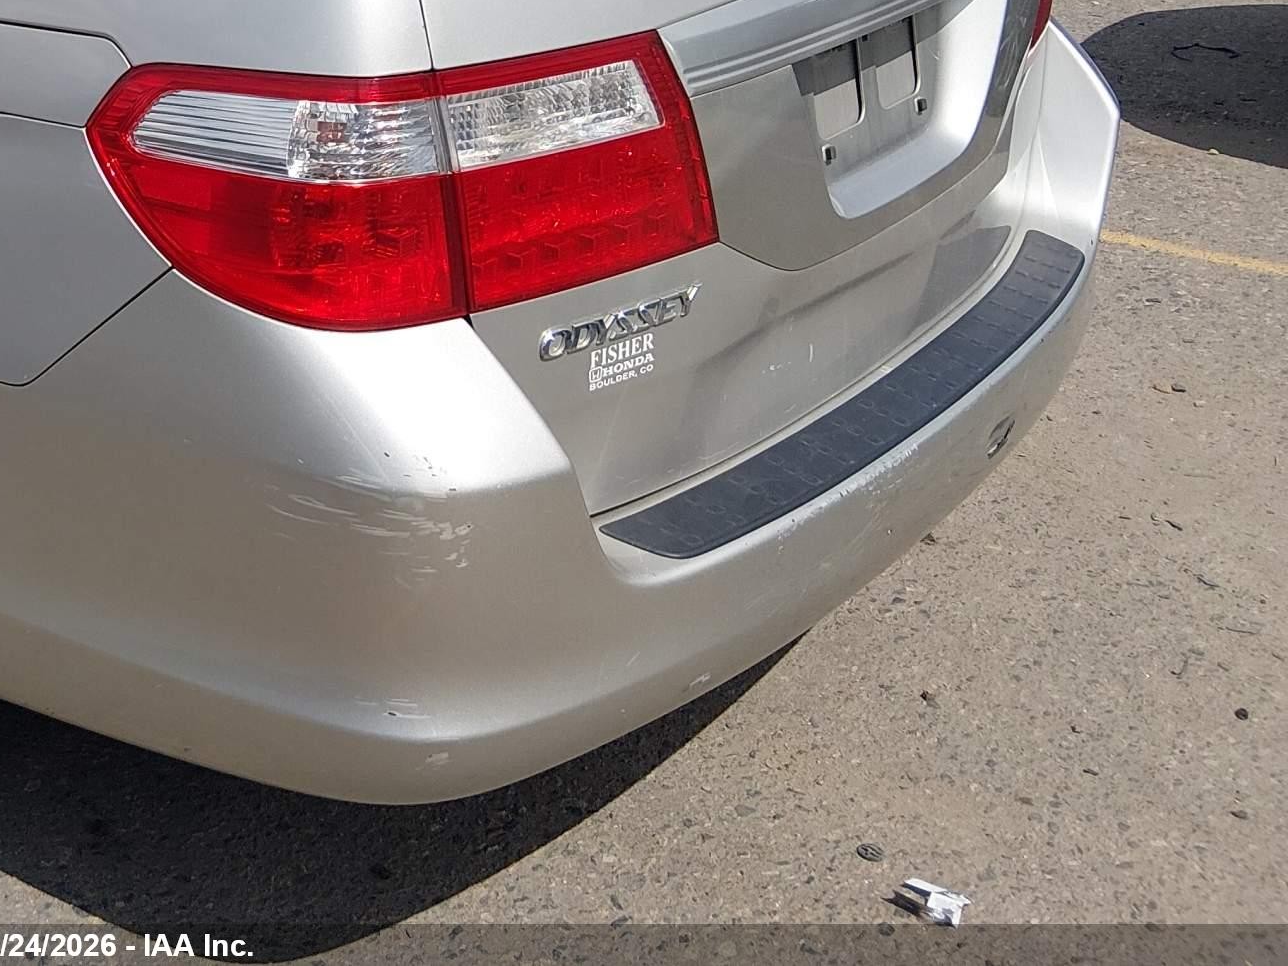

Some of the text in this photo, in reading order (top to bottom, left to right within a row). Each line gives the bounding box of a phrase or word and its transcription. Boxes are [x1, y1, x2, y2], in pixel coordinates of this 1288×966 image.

[539, 282, 703, 361] ODYSSEY
[591, 333, 654, 368] FISHER
[602, 353, 654, 377] HONDA
[589, 364, 653, 391] BOULDER, CO
